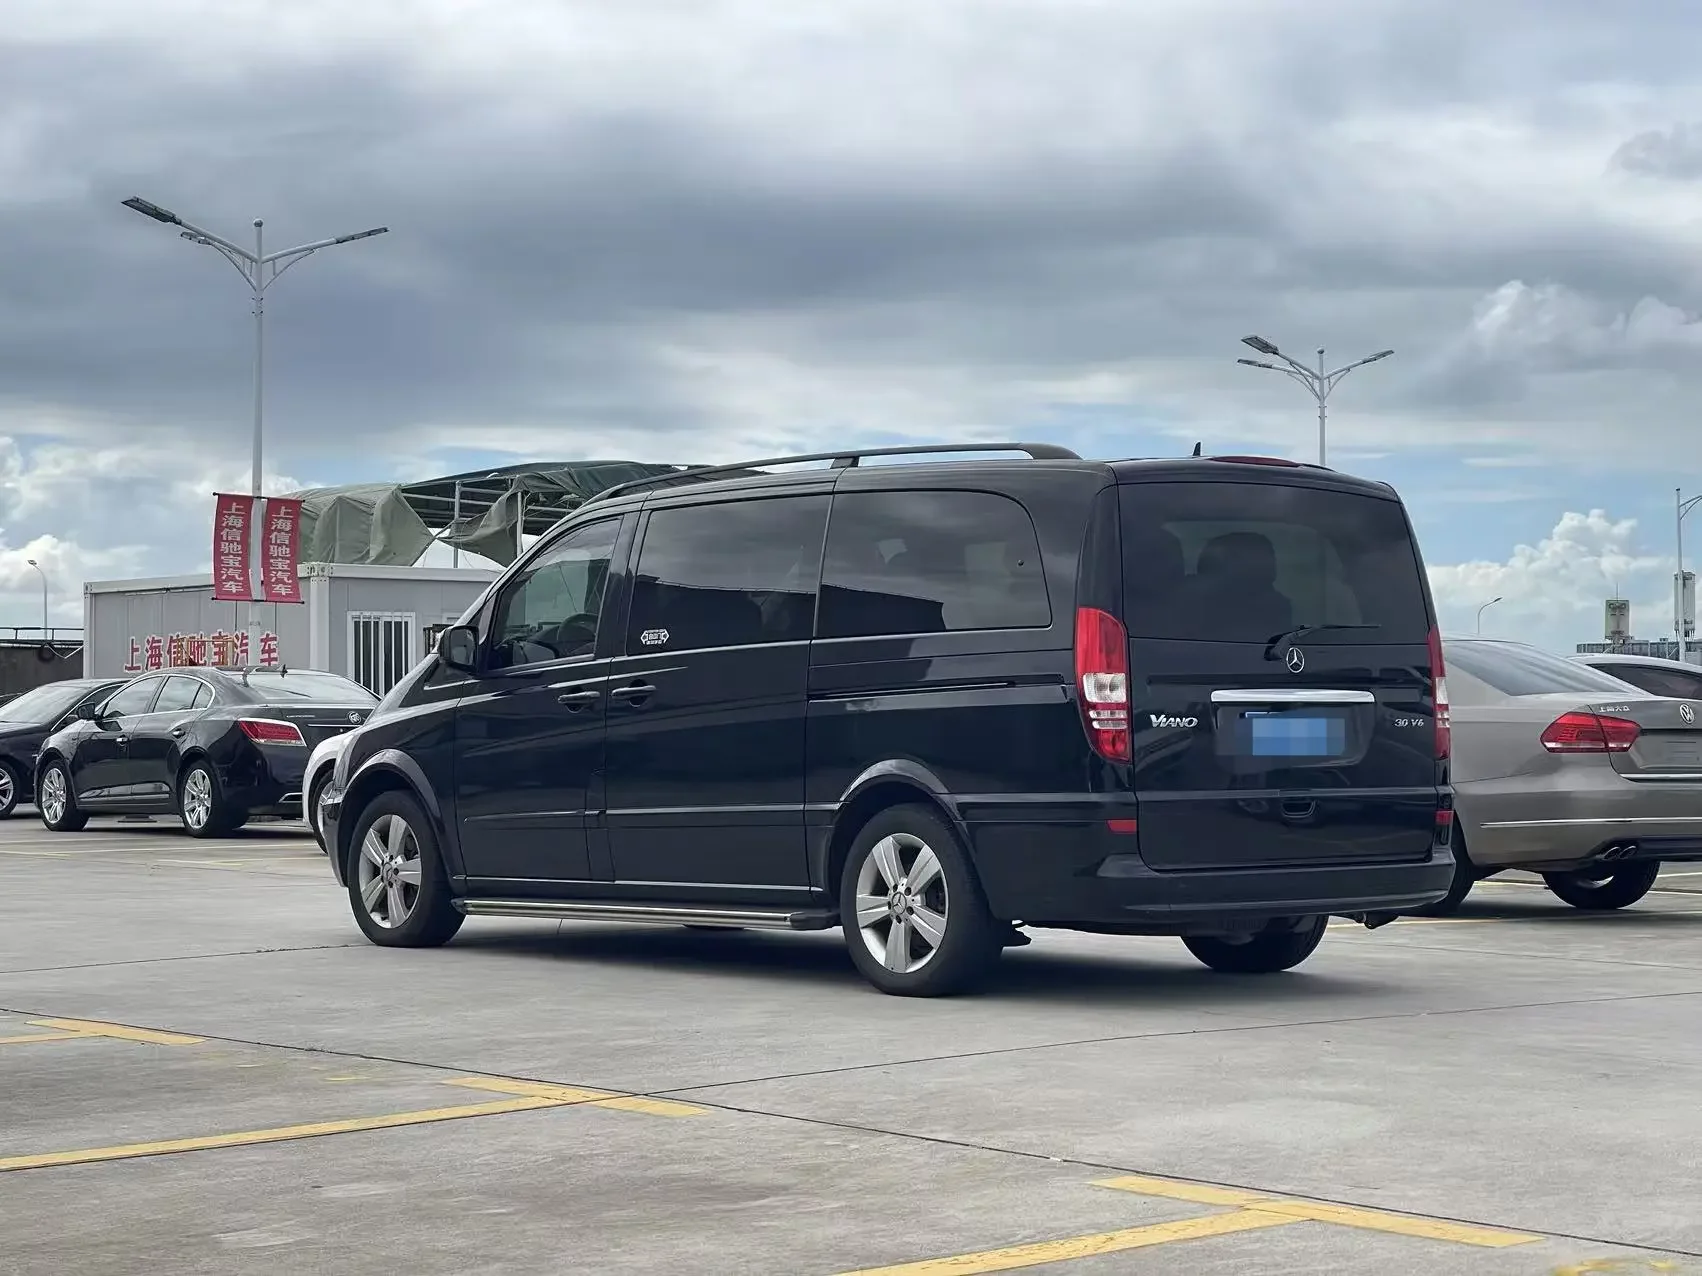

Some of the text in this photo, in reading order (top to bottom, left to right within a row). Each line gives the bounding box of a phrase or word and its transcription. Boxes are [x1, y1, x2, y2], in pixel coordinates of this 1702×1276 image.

[220, 502, 246, 593] 上海信驰宝汽车
[269, 506, 294, 596] 上海信驰宝汽车
[1149, 714, 1199, 728] VIANO
[1410, 718, 1424, 727] V6
